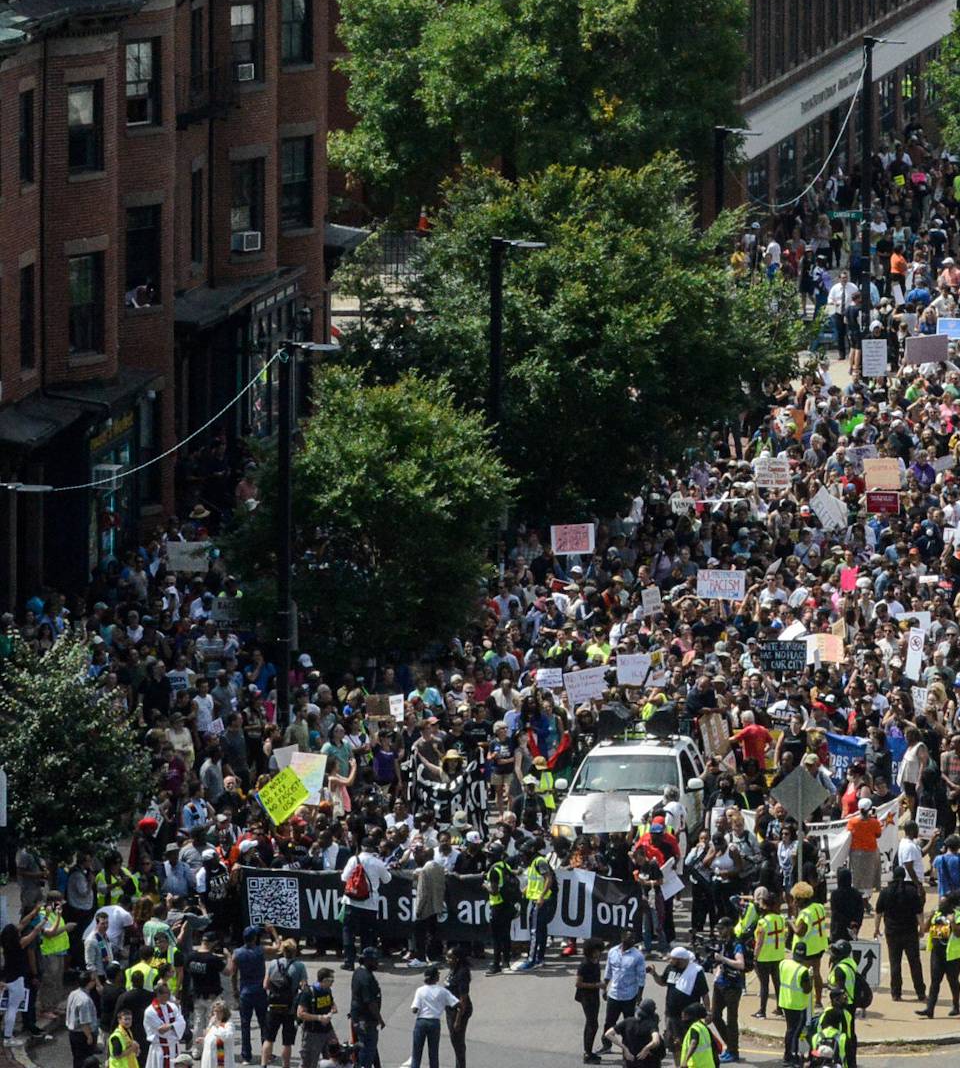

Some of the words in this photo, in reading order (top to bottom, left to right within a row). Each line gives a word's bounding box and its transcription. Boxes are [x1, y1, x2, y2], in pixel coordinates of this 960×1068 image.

[709, 579, 740, 592] RACISM
[829, 753, 849, 767] OBS
[398, 889, 448, 924] sie
[597, 896, 639, 930] on?
